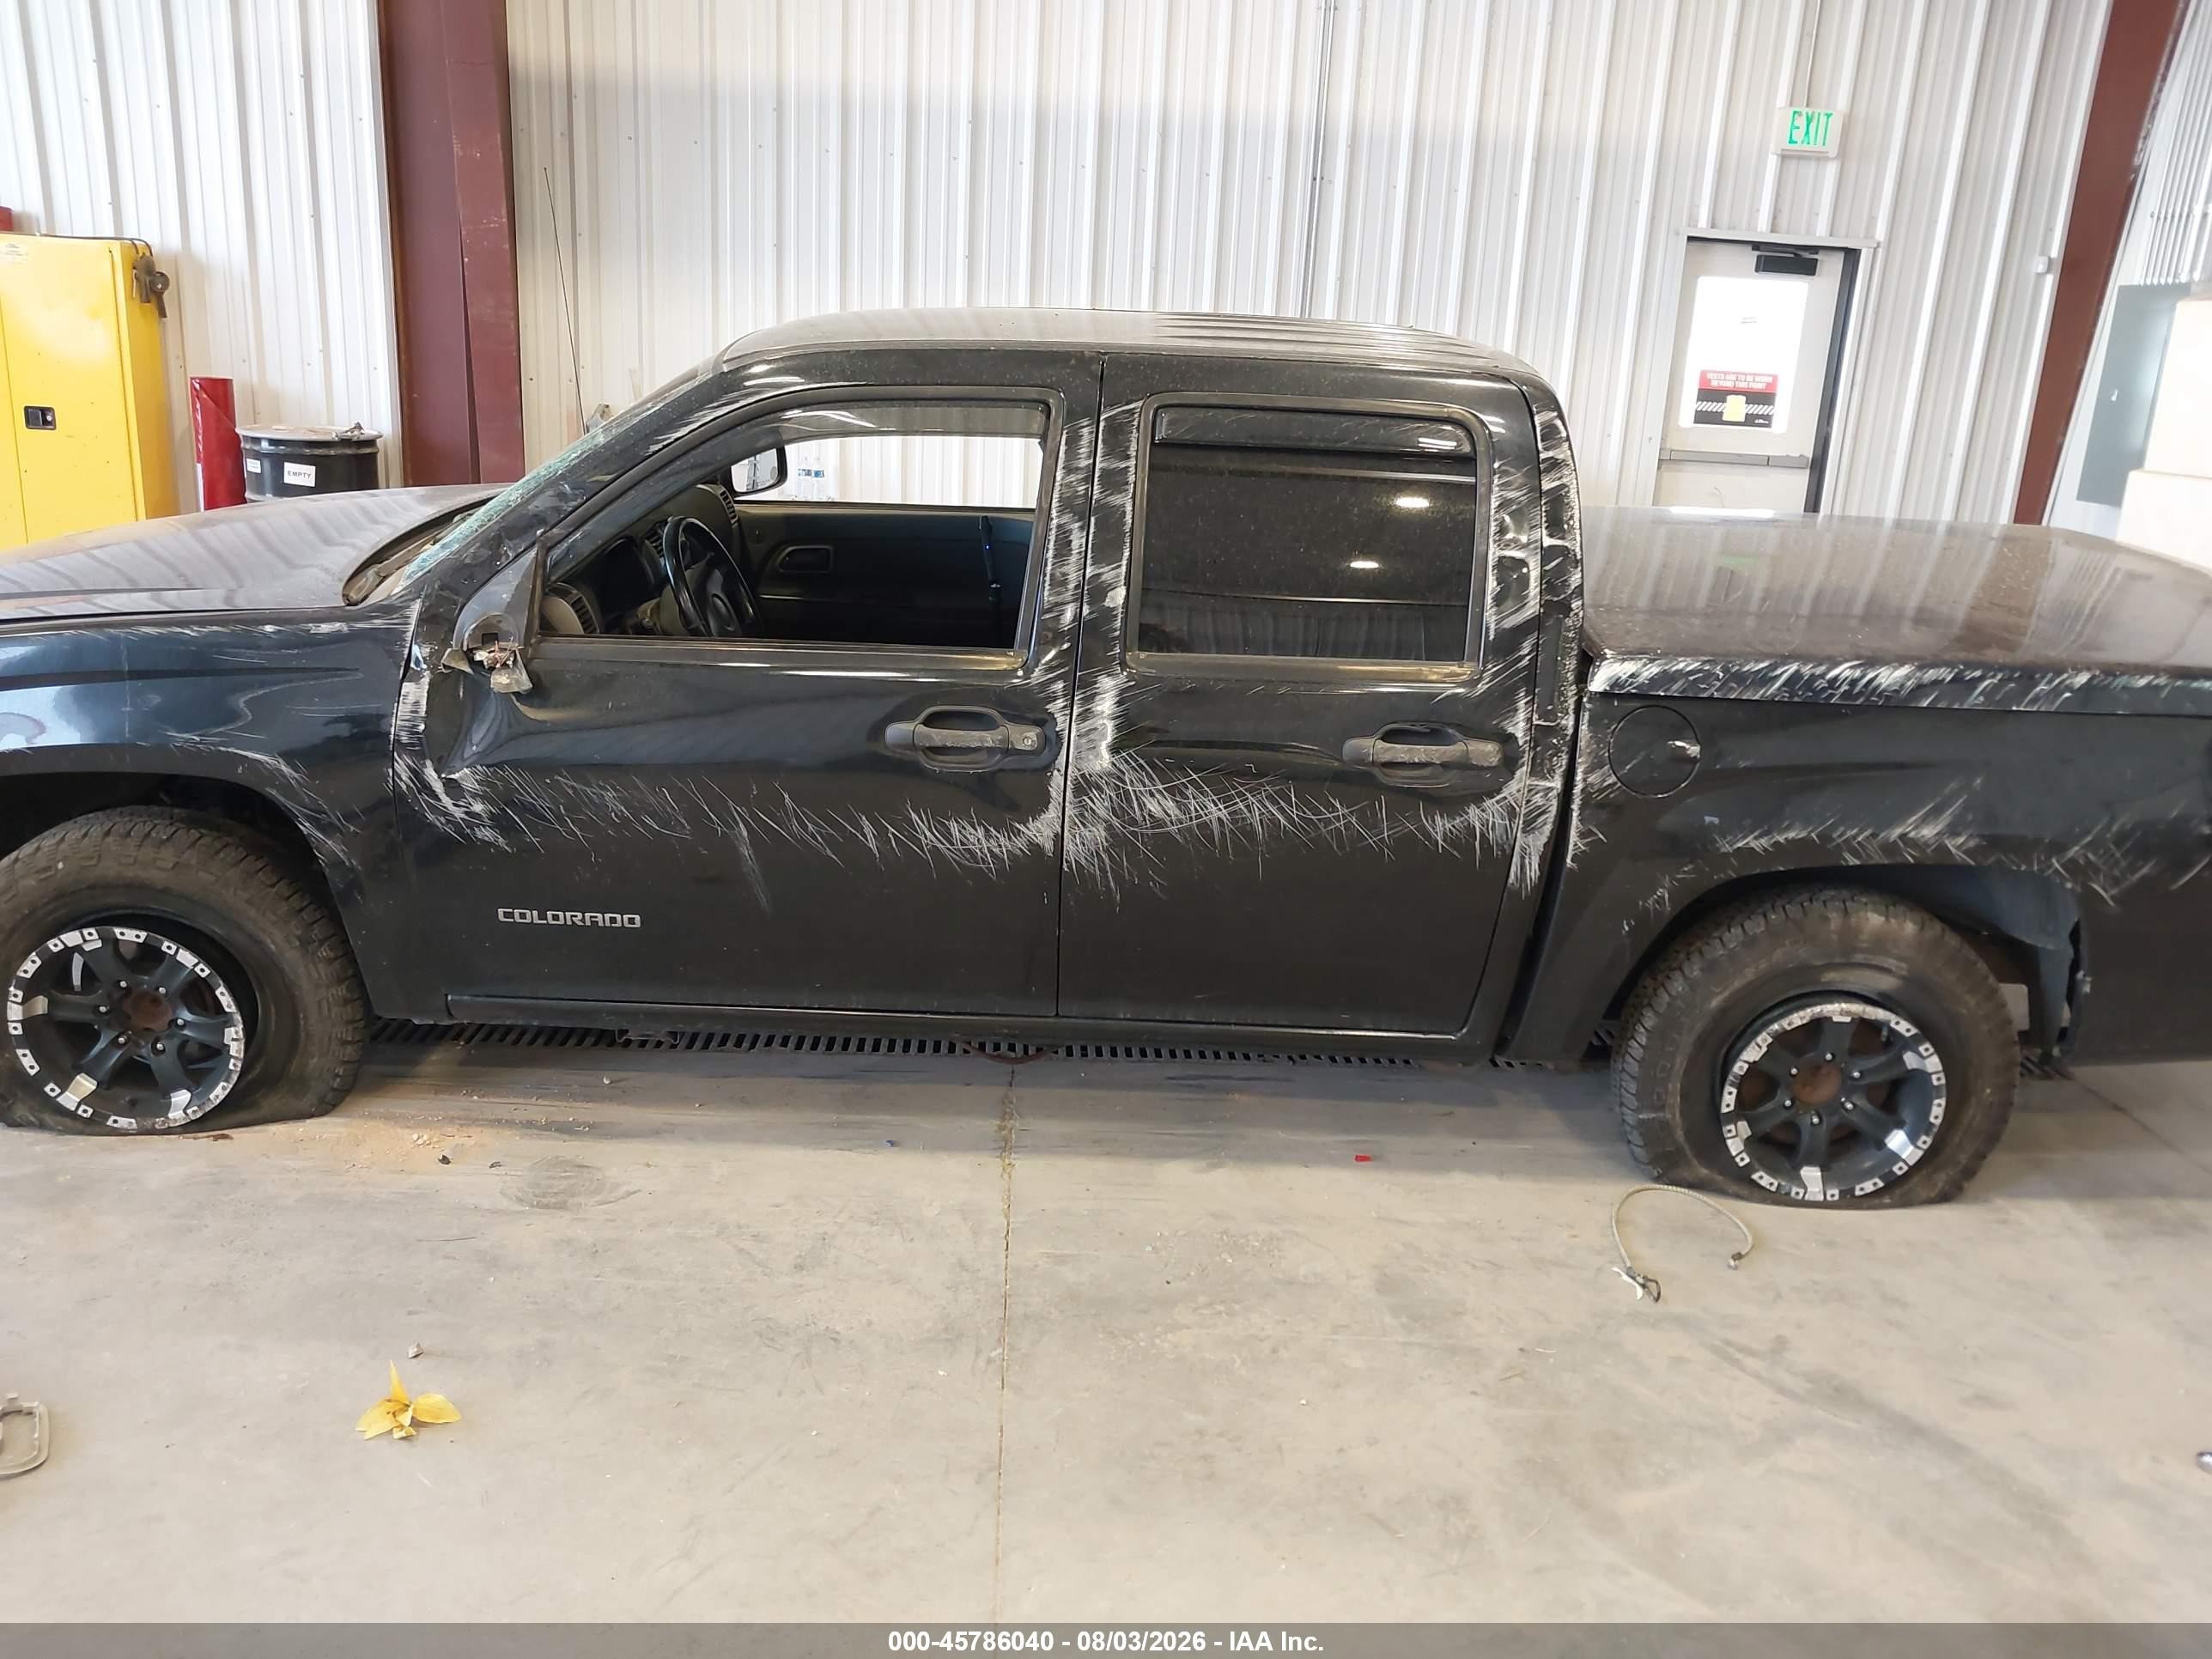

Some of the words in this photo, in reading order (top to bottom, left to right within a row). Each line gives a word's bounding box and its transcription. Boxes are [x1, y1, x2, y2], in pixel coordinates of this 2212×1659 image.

[1789, 111, 1833, 146] EXIT
[288, 470, 312, 478] EMPTY
[497, 908, 641, 928] COLORADO
